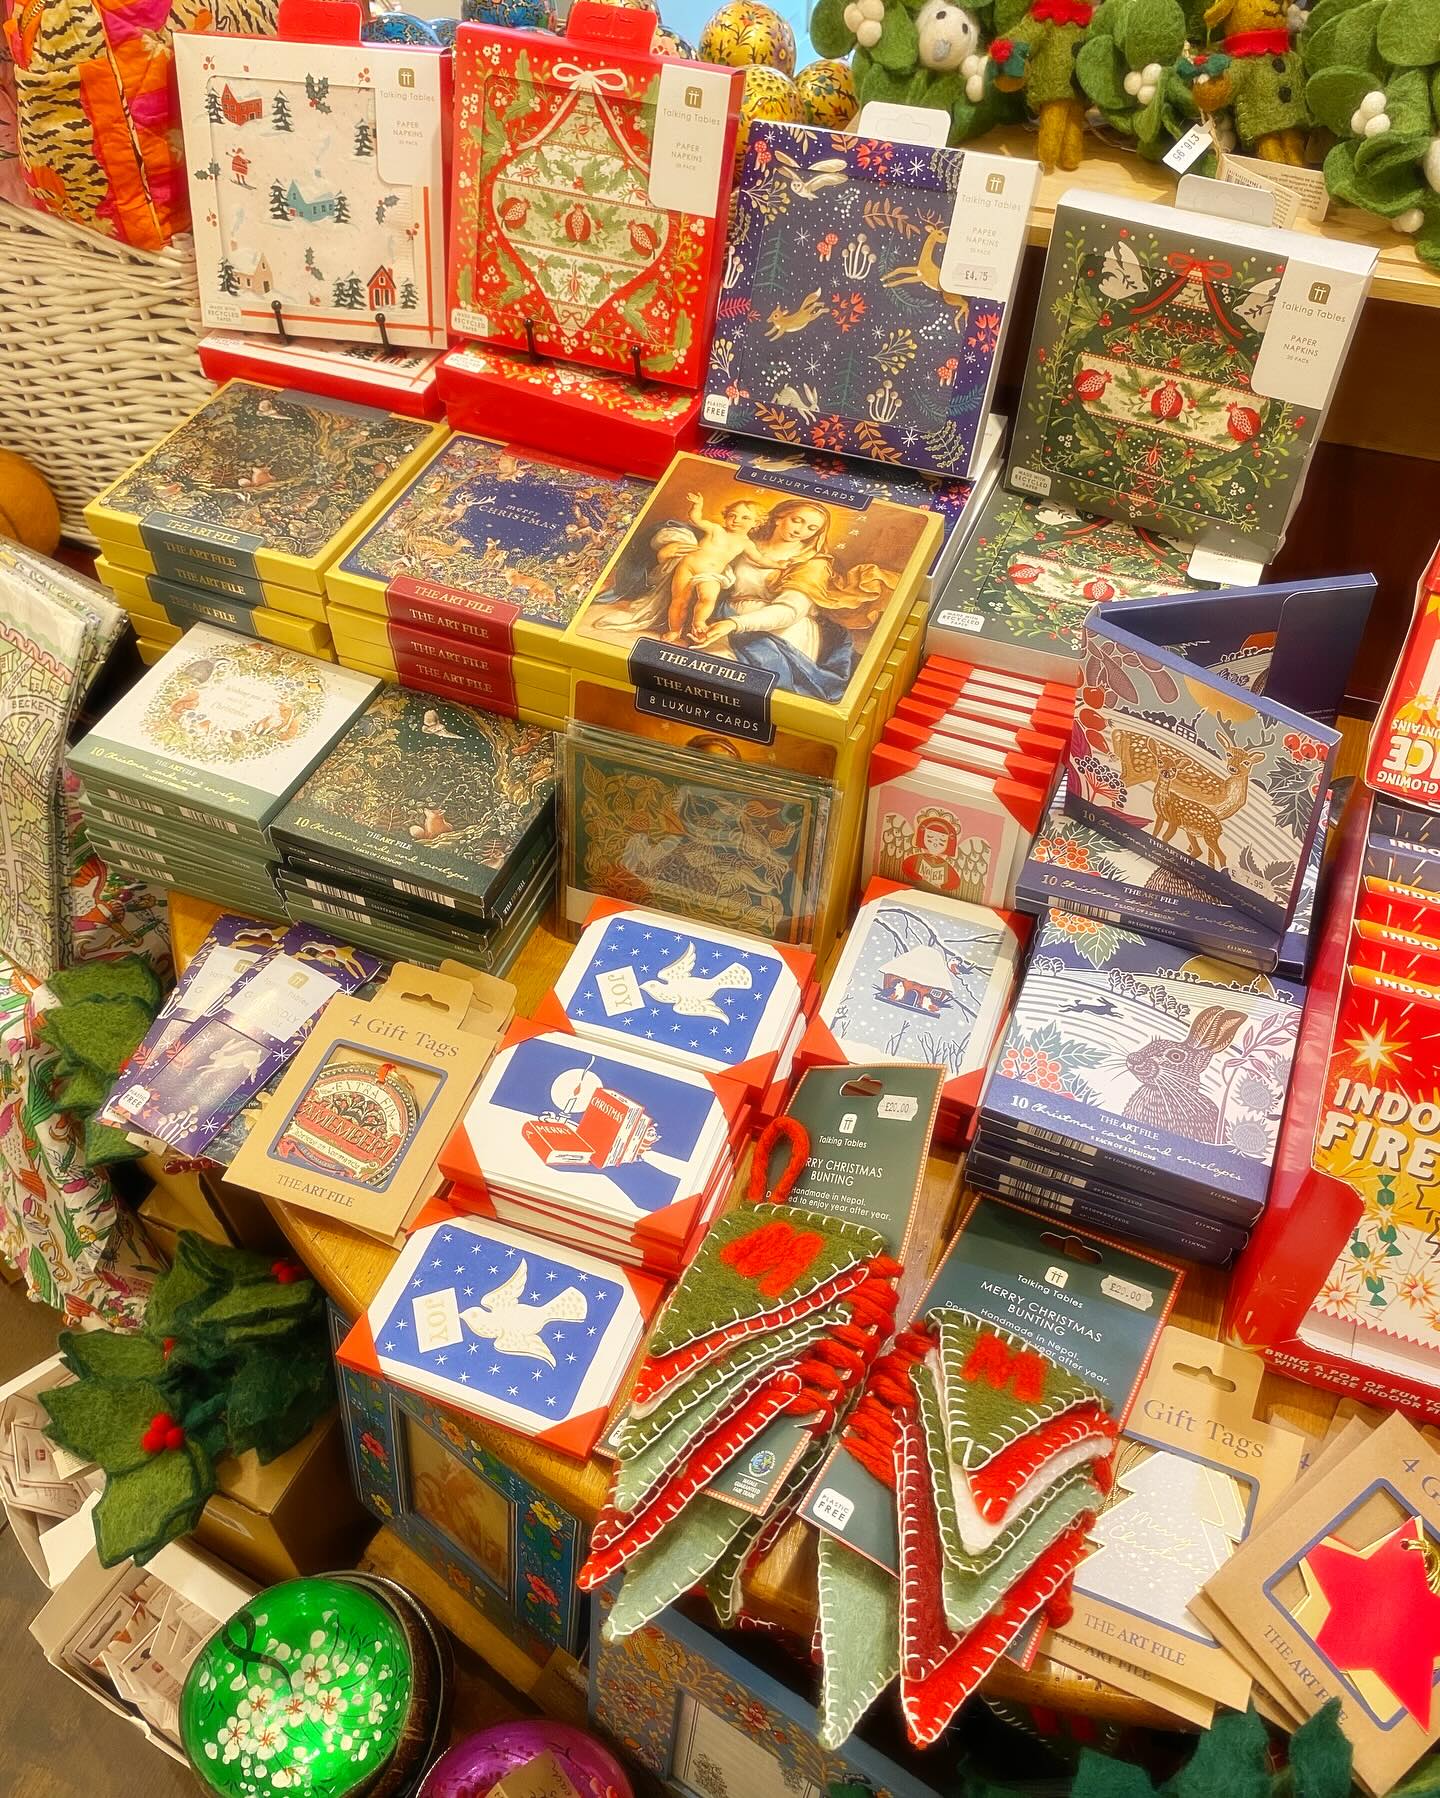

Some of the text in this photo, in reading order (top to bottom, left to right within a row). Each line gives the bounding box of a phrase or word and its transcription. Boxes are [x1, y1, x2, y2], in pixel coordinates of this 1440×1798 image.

[397, 121, 418, 129] PAPER
[663, 108, 720, 125] Talking Tables
[392, 129, 423, 138] NAPKINS
[672, 151, 702, 162] NAPKINS
[676, 143, 700, 152] PAPER
[1172, 134, 1200, 161] £16.95
[962, 195, 991, 208] Talking
[967, 236, 999, 248] NAPKINS
[973, 228, 996, 236] PAPER
[965, 270, 988, 281] £4.75
[208, 310, 239, 319] RECYCLED
[454, 316, 486, 329] RECYCLED
[1282, 301, 1346, 323] Talking Tables
[1283, 343, 1318, 357] NAPKINS
[1291, 335, 1317, 347] PAPER
[706, 408, 725, 416] FREE
[707, 400, 726, 408] PLASTIC
[762, 473, 809, 490] LUXURY
[814, 487, 855, 502] CARDS
[1015, 475, 1048, 488] RECYCLED
[478, 506, 558, 530] CHRISTMAS
[505, 504, 541, 517] merry
[167, 519, 241, 544] THE ART FILE
[163, 541, 237, 567] THE ART FILE
[175, 568, 247, 596] THE ART FILE
[415, 585, 495, 614] THE ART FILE
[192, 603, 237, 624] ART FILE
[409, 608, 489, 639] THE ART FILE
[942, 614, 980, 626] RECYCLED
[411, 641, 489, 671] THE ART FILE
[659, 650, 747, 683] THE ART FILE
[416, 664, 493, 693] THE ART FILE
[653, 675, 741, 708] THE ART FILE
[649, 695, 759, 732] 8 LUXURY CARDS
[90, 746, 105, 757] 10
[1376, 771, 1439, 795] GLOWING
[1083, 810, 1095, 822] 10
[294, 816, 469, 882] 10 Christmas cards and envelopes
[366, 830, 413, 851] THE ART FILE
[1165, 847, 1196, 867] ART FILE
[1041, 874, 1118, 901] 10 Christmas
[1245, 875, 1264, 889] 7.95
[1123, 886, 1179, 906] THE FILE
[607, 974, 632, 1009] JOY
[349, 1013, 460, 1058] 4 Gift Tags
[124, 1094, 143, 1108] FREE
[591, 1097, 624, 1123] CHRISTMAS
[884, 1102, 910, 1113] £20.00
[1333, 1077, 1440, 1134] INDO
[525, 1125, 571, 1138] A MERRY
[1010, 1095, 1028, 1110] 10
[1031, 1102, 1097, 1131] Christmas
[1101, 1128, 1140, 1146] cards
[1143, 1141, 1172, 1157] and
[1176, 1154, 1244, 1181] envelopes
[1100, 1115, 1159, 1141] THE ART FILE
[819, 1135, 867, 1149] Talking Tables
[1095, 1136, 1156, 1162] EACH OF DESIGNS
[811, 1172, 854, 1187] BUNTING
[825, 1160, 883, 1178] CHRISTMAS
[276, 1174, 355, 1208] THE ART FILE
[791, 1187, 831, 1200] Handmade
[832, 1193, 838, 1201] in
[841, 1195, 866, 1207] Nepal.
[809, 1199, 829, 1210] enjoy
[830, 1202, 848, 1214] year
[850, 1205, 869, 1216] after
[870, 1209, 892, 1221] year.
[1017, 1274, 1083, 1309] Talking Tables
[1109, 1282, 1142, 1302] £20.00
[426, 1299, 448, 1343] JOY
[980, 1281, 1103, 1342] MERRY CHRISTMAS
[1007, 1304, 1065, 1336] BUNTING
[980, 1308, 1080, 1361] Handmade in Nepal.
[960, 1331, 1048, 1404] M
[1059, 1354, 1110, 1386] after year.
[1265, 1348, 1421, 1401] BRING A POP OF FUN
[1274, 1359, 1422, 1409] WITH THESE INDOOR
[1143, 1399, 1265, 1458] Gift Tags
[1402, 1459, 1420, 1473] 4
[818, 1501, 845, 1522] FREE
[822, 1494, 849, 1513] PLASTIC
[1085, 1613, 1186, 1666] THE ART FILE
[1262, 1625, 1320, 1695] THE ART
